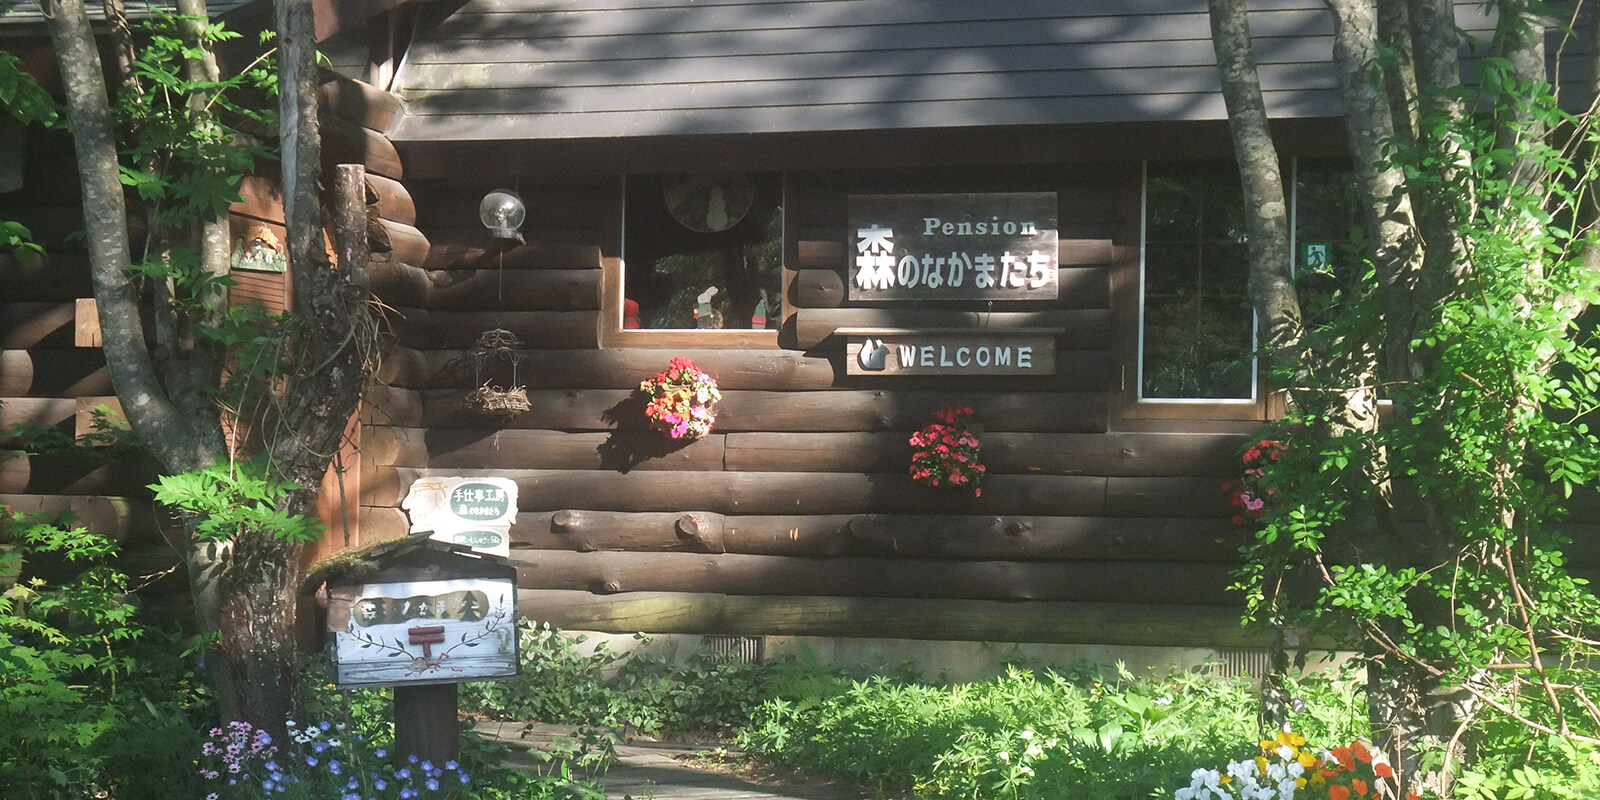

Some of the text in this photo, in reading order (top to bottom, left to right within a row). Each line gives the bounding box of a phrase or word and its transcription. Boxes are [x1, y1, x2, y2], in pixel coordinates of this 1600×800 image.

[923, 216, 1037, 236] Pension
[856, 224, 1050, 290] 森のなかまたち
[899, 345, 1033, 368] WELCOME
